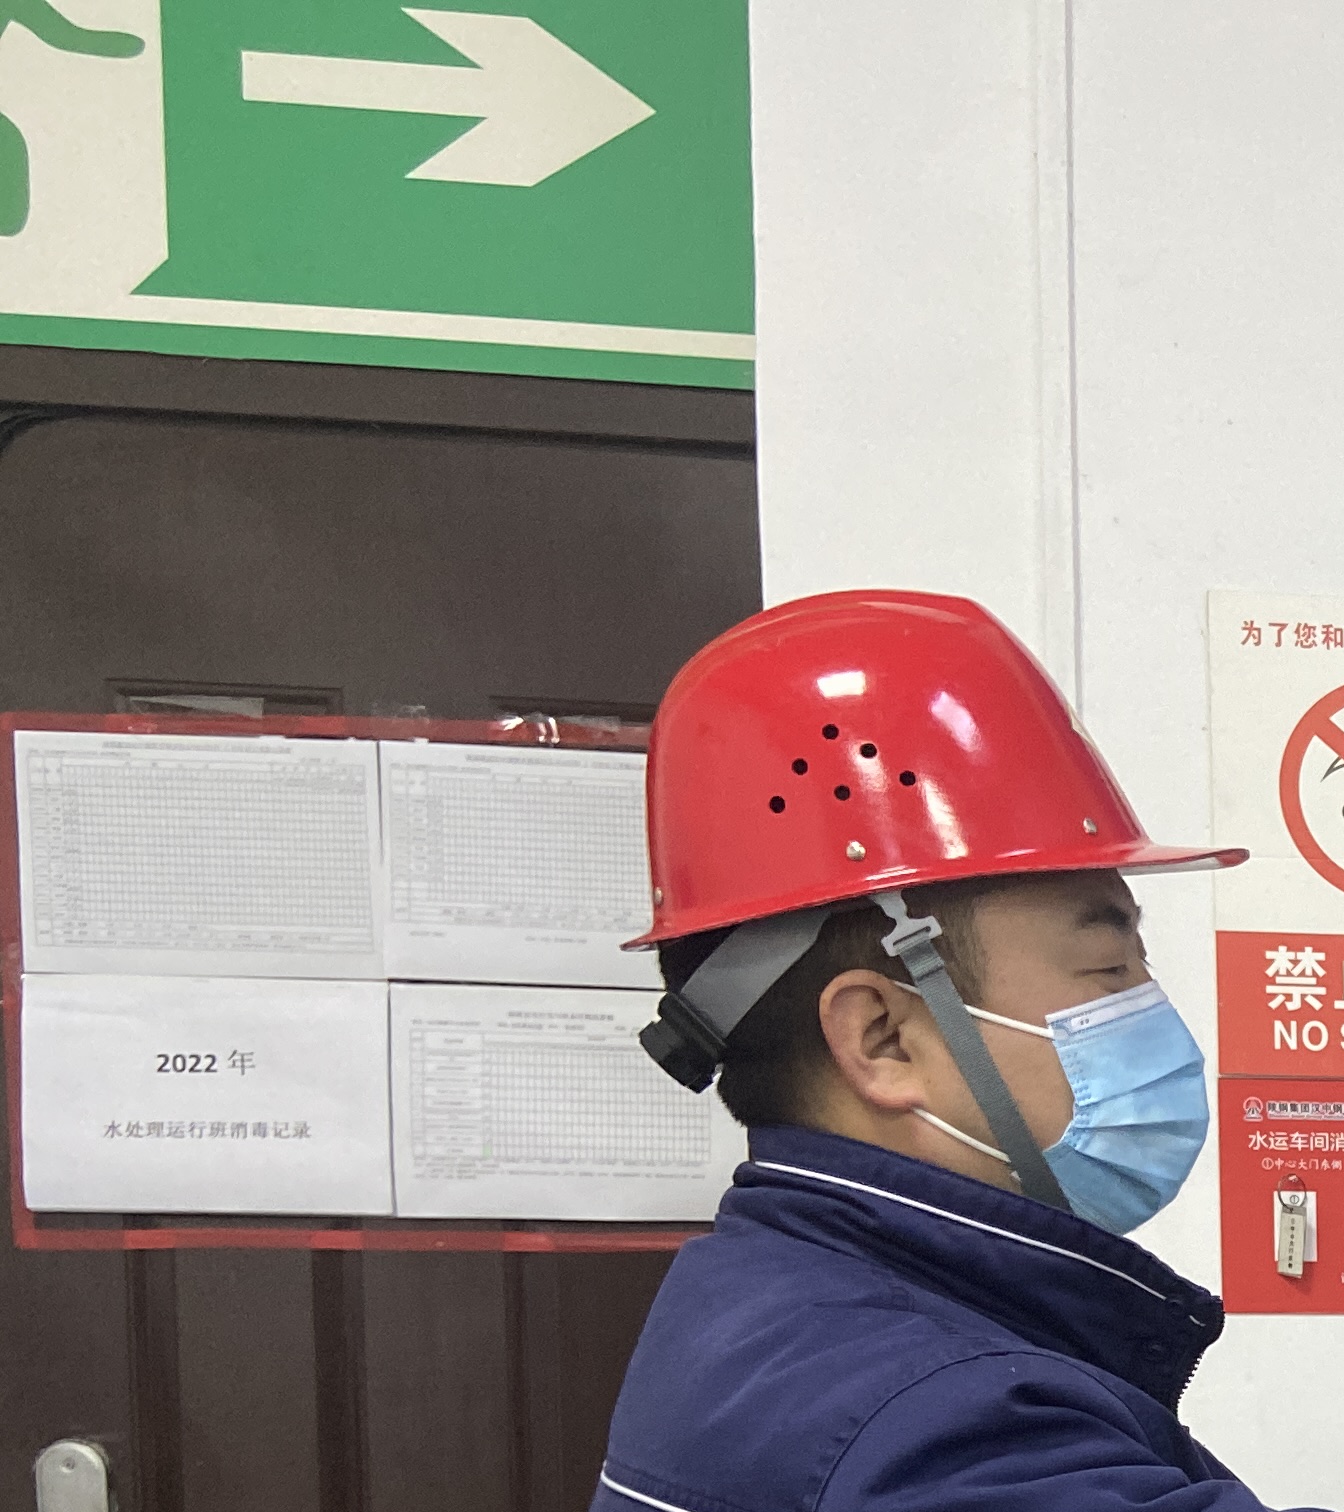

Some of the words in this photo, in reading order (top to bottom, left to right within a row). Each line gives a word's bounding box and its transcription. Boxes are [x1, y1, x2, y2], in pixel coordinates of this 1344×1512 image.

[1273, 1020, 1328, 1051] NO
[156, 1054, 217, 1072] 2022
[227, 1049, 256, 1076] 年
[104, 1120, 312, 1139] 水处理运行班消毒记录
